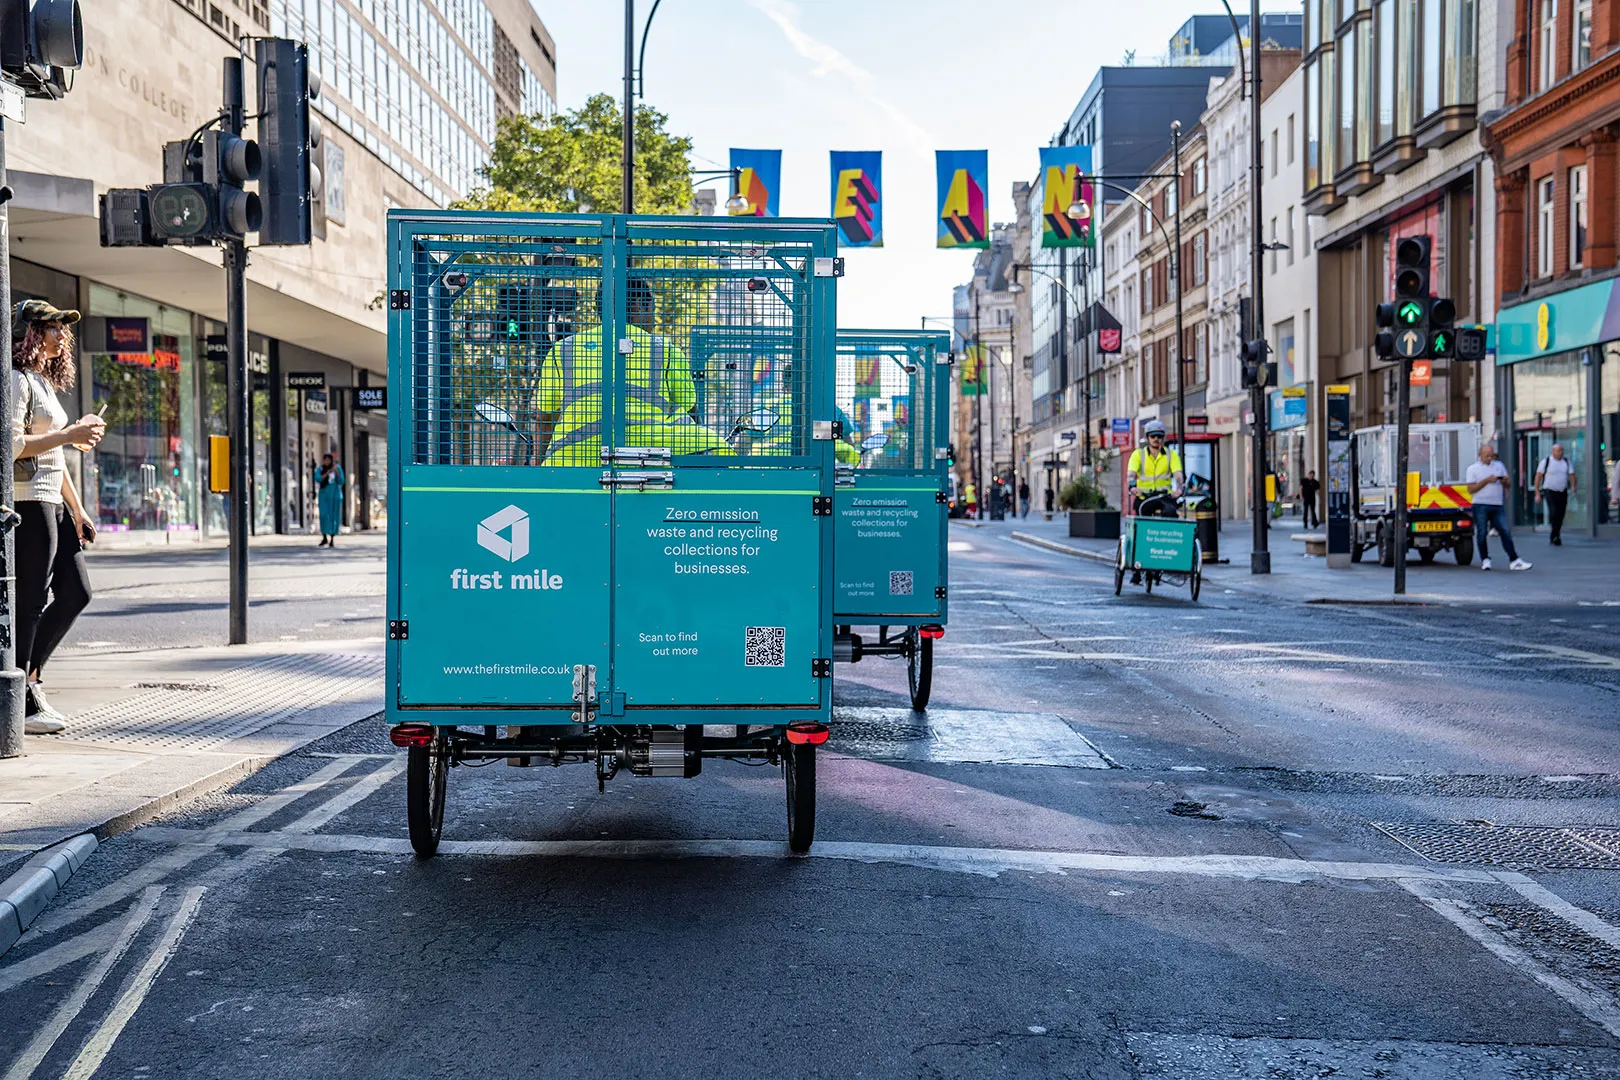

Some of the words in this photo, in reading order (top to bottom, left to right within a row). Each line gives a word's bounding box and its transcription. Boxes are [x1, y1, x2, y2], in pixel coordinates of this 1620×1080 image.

[119, 68, 187, 124] COLLEGE
[208, 344, 228, 352] POL
[290, 377, 323, 385] GEOX
[359, 390, 383, 400] SOLE
[852, 498, 872, 506] Zero
[873, 498, 907, 506] emission
[666, 507, 698, 520] Zero
[700, 507, 759, 520] emission
[841, 509, 865, 517] waste
[866, 508, 881, 517] and
[882, 509, 918, 519] recycling
[851, 519, 895, 527] collections
[896, 519, 908, 527] for
[647, 527, 686, 539] waste
[689, 526, 714, 539] and
[717, 525, 779, 541] recycling
[857, 529, 902, 538] businesses.
[664, 543, 738, 557] collections
[741, 543, 760, 557] for
[1150, 547, 1163, 555] first
[674, 561, 750, 575] businesses.
[450, 568, 503, 590] first
[511, 568, 563, 590] mile
[639, 631, 663, 643] Scan
[665, 632, 676, 643] to
[678, 631, 698, 643] find
[652, 646, 669, 657] out
[672, 646, 698, 657] more
[443, 663, 571, 676] www.thefirstmile.co.uk
